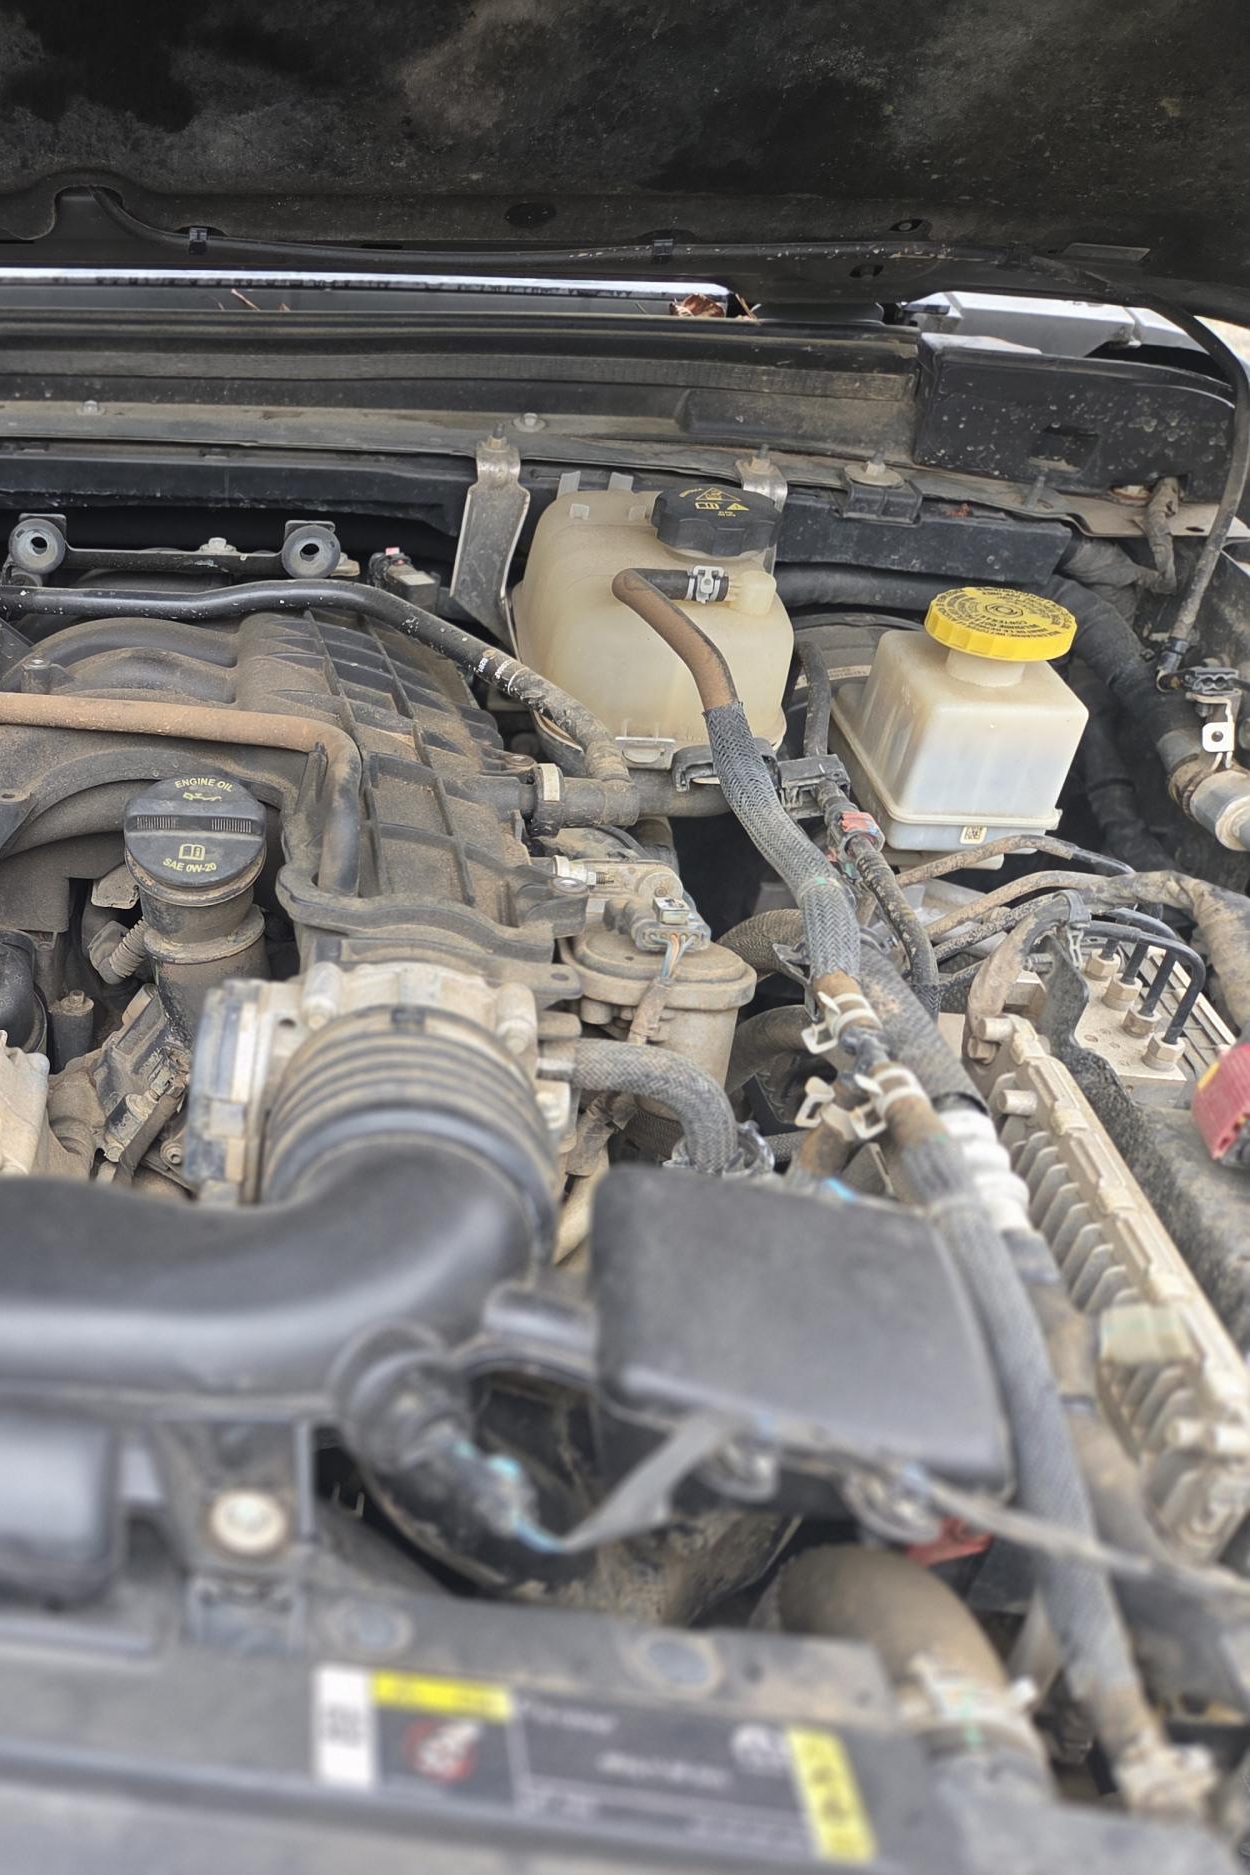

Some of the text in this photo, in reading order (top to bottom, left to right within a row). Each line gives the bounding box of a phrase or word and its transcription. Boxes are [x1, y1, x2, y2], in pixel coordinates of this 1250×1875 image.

[175, 777, 233, 792] ENGINE OIL
[162, 858, 217, 873] SAE 0W-20
